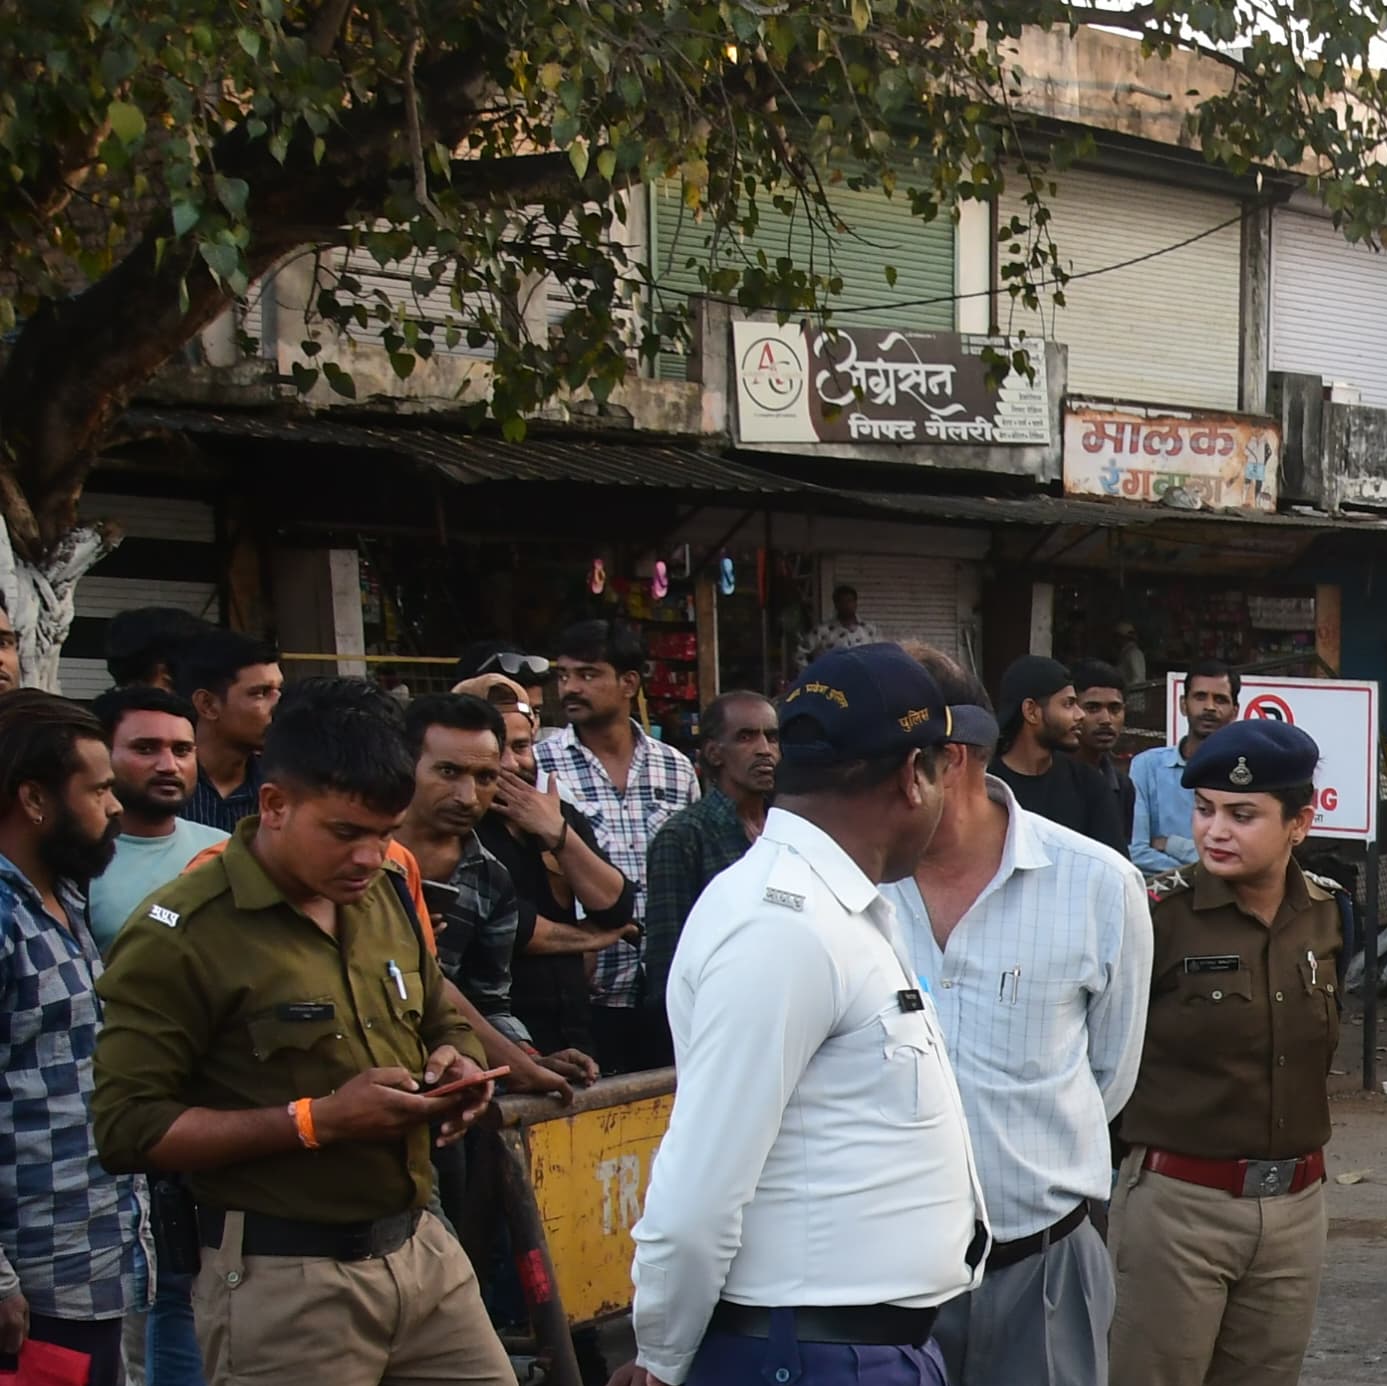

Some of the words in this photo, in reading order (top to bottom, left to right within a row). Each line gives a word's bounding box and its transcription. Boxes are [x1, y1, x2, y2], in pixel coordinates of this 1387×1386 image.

[848, 412, 916, 441] गिफ्ट
[925, 414, 994, 442] गेलरी
[898, 707, 930, 732] पुलिस
